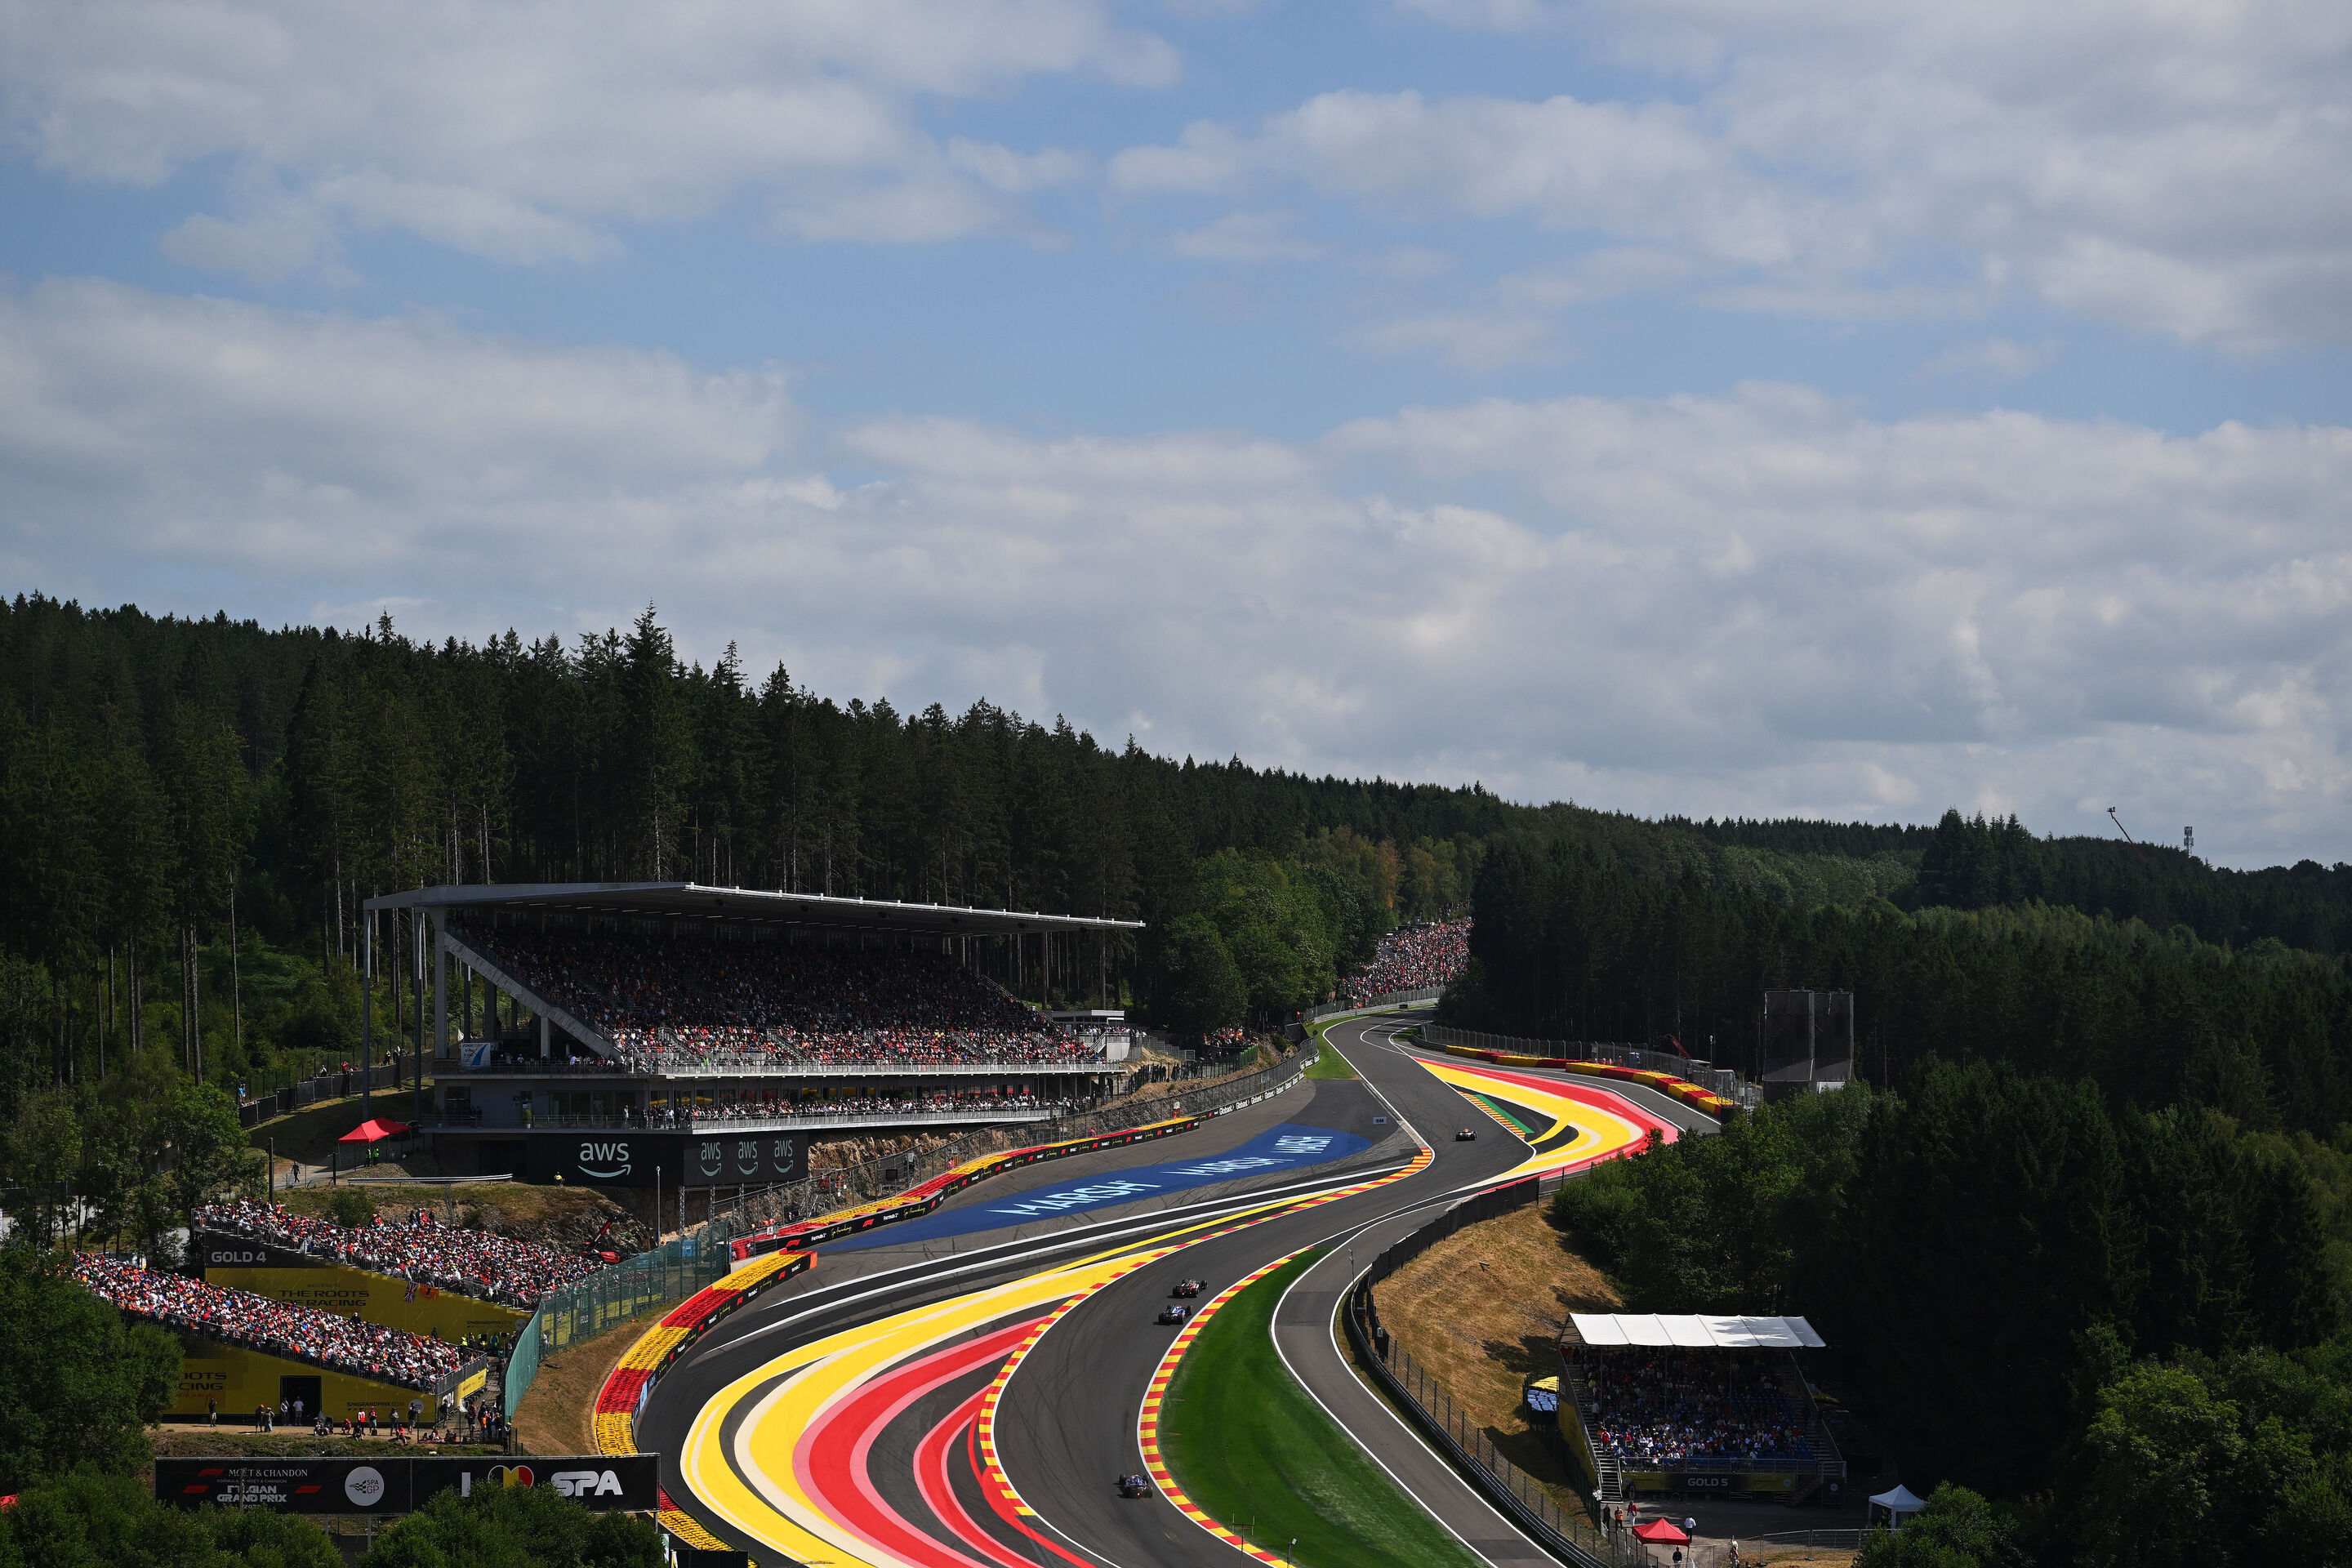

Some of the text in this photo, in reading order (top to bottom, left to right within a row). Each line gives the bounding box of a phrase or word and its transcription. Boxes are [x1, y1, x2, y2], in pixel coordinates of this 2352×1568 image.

[1219, 1105, 1232, 1115] Globant
[580, 1143, 630, 1161] aws
[701, 1142, 721, 1160] aws
[737, 1140, 757, 1159] aws
[774, 1139, 793, 1157] aws
[984, 1181, 1162, 1215] MARSH
[211, 1251, 267, 1263] GOLD 4
[184, 1372, 227, 1380] OTS
[264, 1469, 308, 1477] CHANDON
[461, 1470, 623, 1497] I SPA
[1687, 1477, 1729, 1487] GOLD 5
[367, 1486, 380, 1494] GP
[216, 1494, 287, 1503] GRAND PRIX
